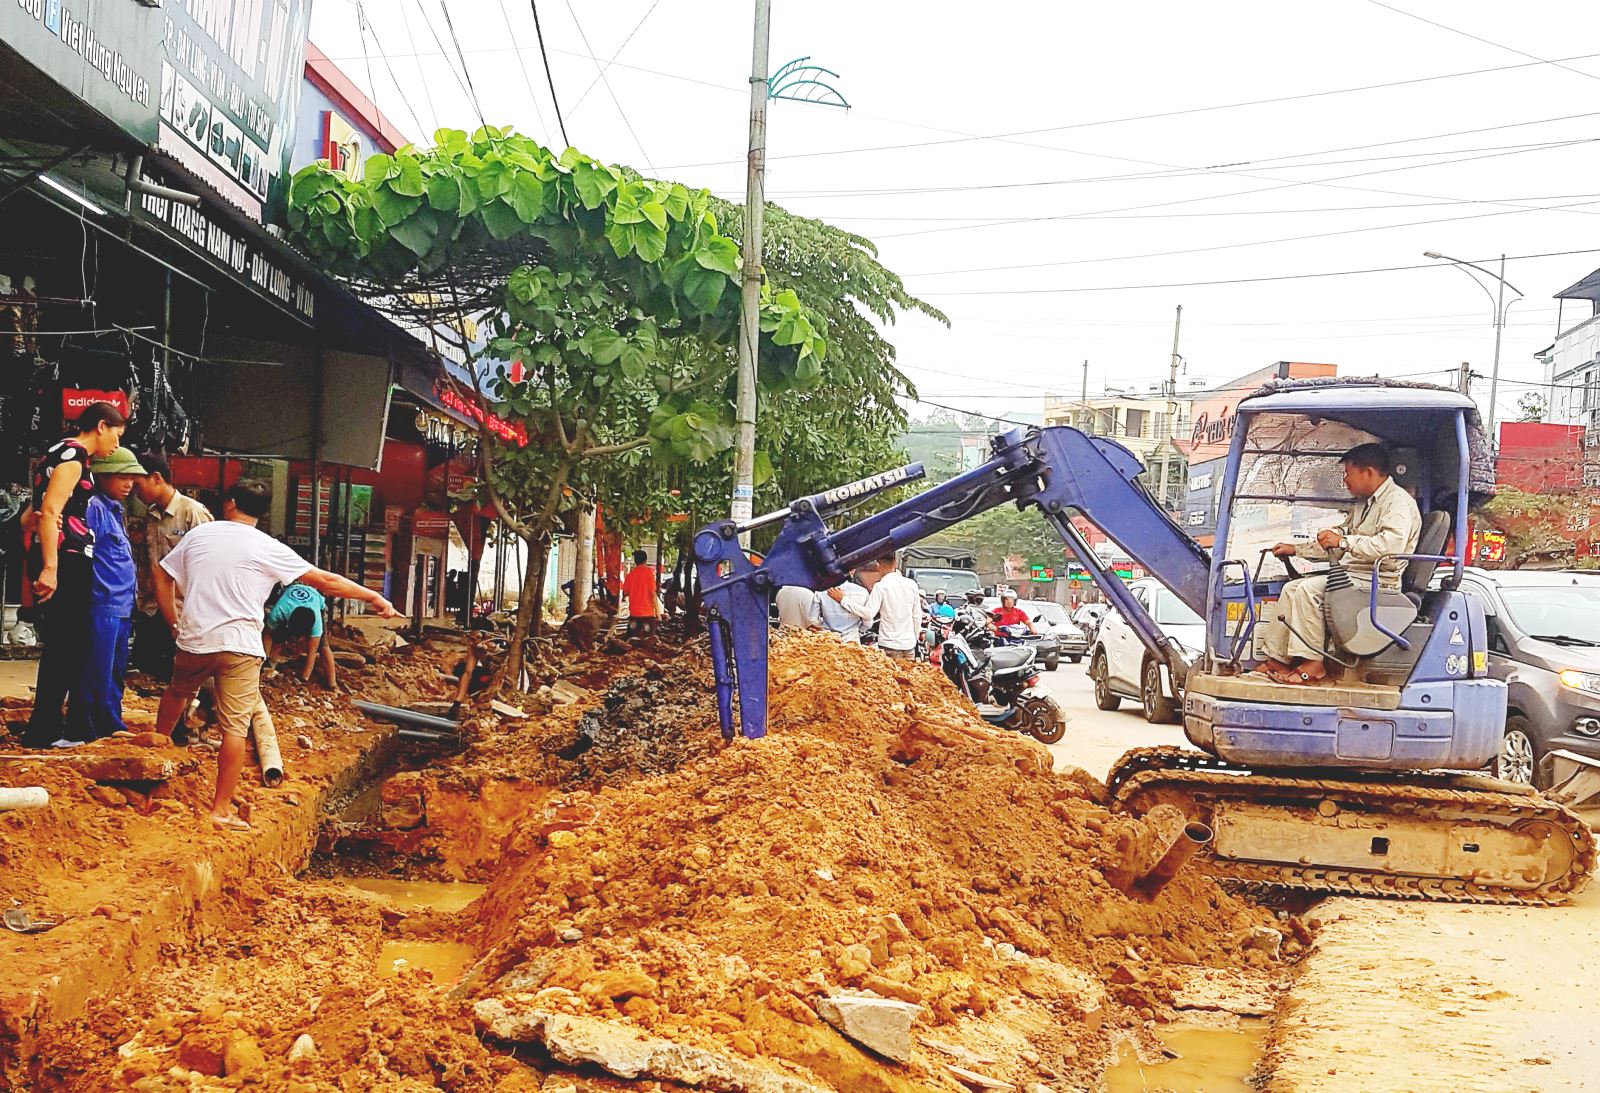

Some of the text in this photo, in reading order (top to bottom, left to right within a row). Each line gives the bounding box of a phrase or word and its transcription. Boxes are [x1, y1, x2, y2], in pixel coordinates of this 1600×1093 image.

[85, 27, 112, 81] Hung
[112, 50, 150, 108] Nguyen
[171, 201, 206, 247] TRANG
[207, 221, 231, 263] NAM
[231, 237, 248, 274] NỮ
[252, 253, 269, 288] DÂY
[270, 266, 290, 303] LƯNG
[68, 397, 111, 407] adid
[824, 467, 908, 505] KOMATSU
